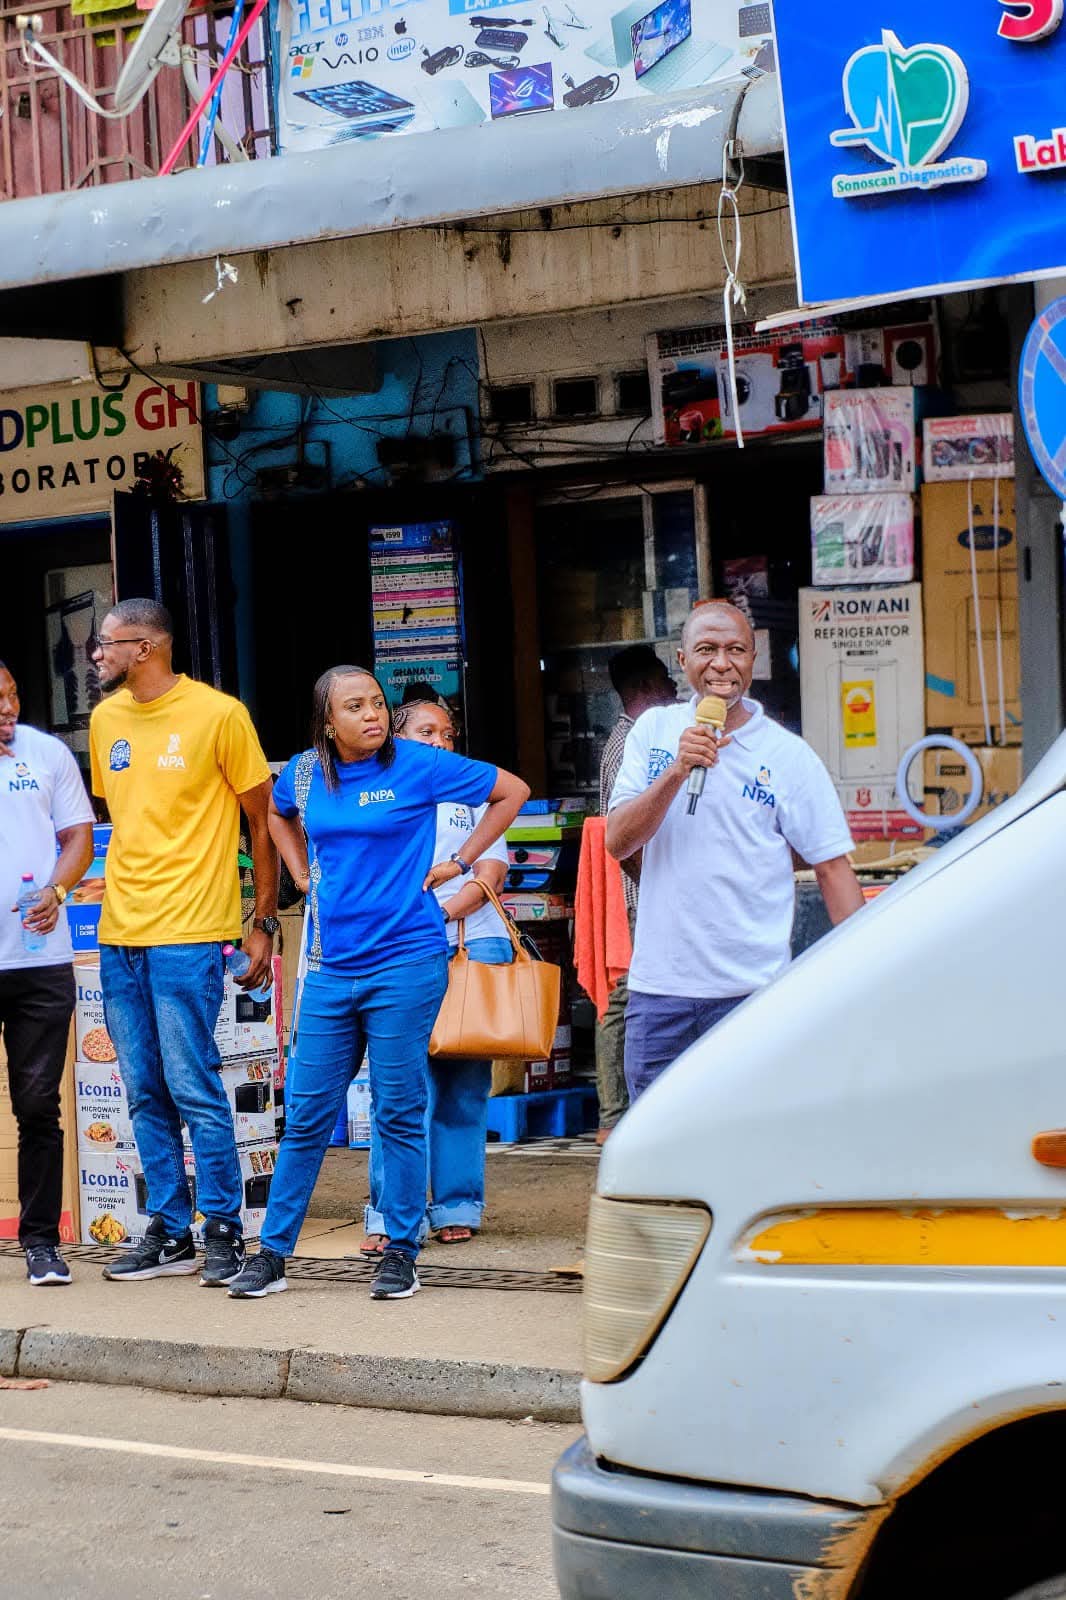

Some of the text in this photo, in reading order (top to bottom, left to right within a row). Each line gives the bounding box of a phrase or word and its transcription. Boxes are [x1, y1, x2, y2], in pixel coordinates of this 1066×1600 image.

[358, 24, 385, 41] IBM
[289, 41, 325, 57] acer
[322, 47, 379, 69] VAIO
[836, 163, 973, 193] Sonoscan Diagnostics
[134, 382, 197, 431] GH
[0, 448, 176, 497] ORATOR
[833, 598, 910, 615] ROMANI
[814, 624, 910, 640] REFRIGERATOR
[158, 755, 186, 769] NPA
[9, 779, 40, 792] NPA
[370, 789, 396, 801] NPA
[742, 784, 777, 809] NPA
[78, 1081, 121, 1097] Icona
[81, 1105, 121, 1114] MICROWAVE
[81, 1169, 129, 1188] Icona
[87, 1195, 126, 1204] MICROWAVE
